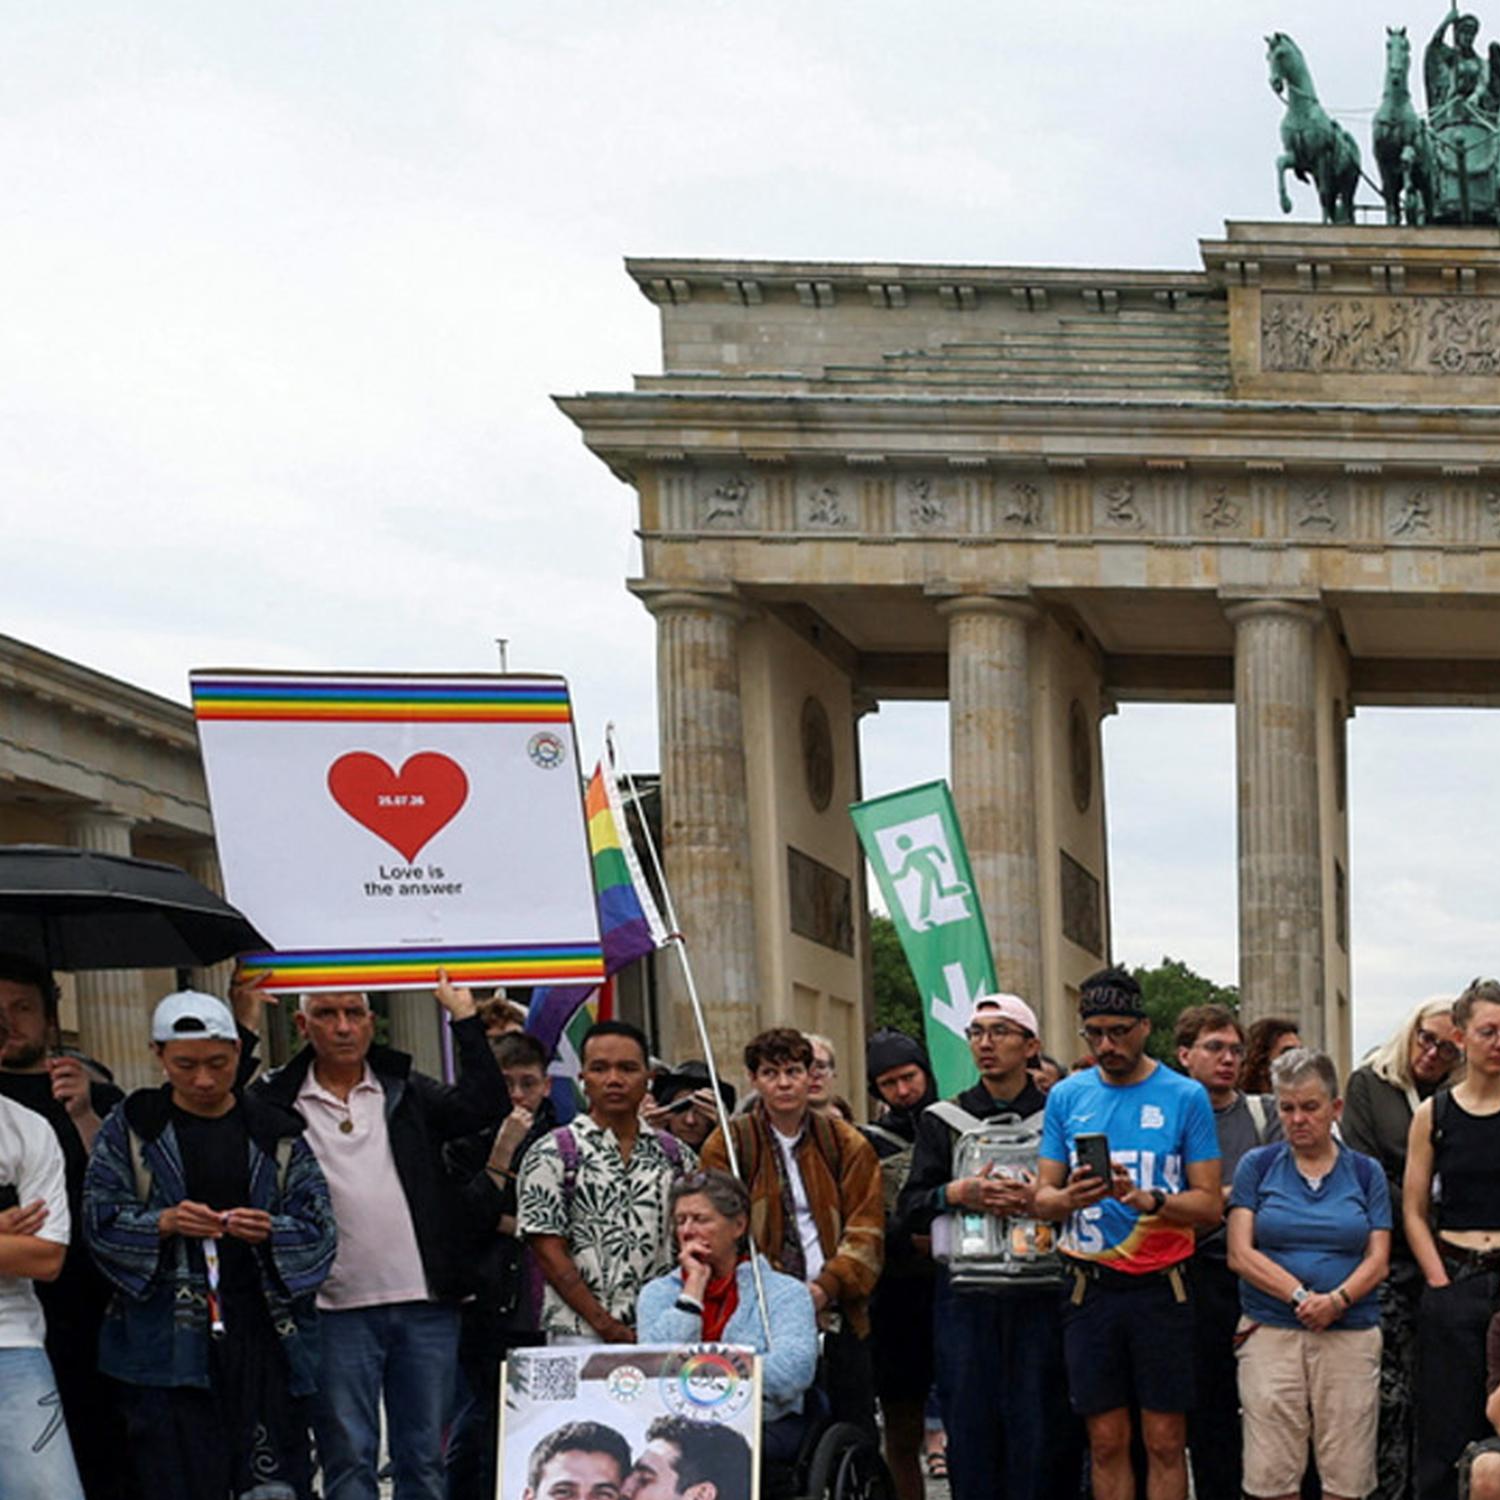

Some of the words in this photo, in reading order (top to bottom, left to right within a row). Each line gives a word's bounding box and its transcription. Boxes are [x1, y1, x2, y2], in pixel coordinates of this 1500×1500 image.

[379, 865, 424, 880] Love
[428, 864, 445, 879] is
[364, 882, 394, 896] the
[399, 882, 463, 896] answer
